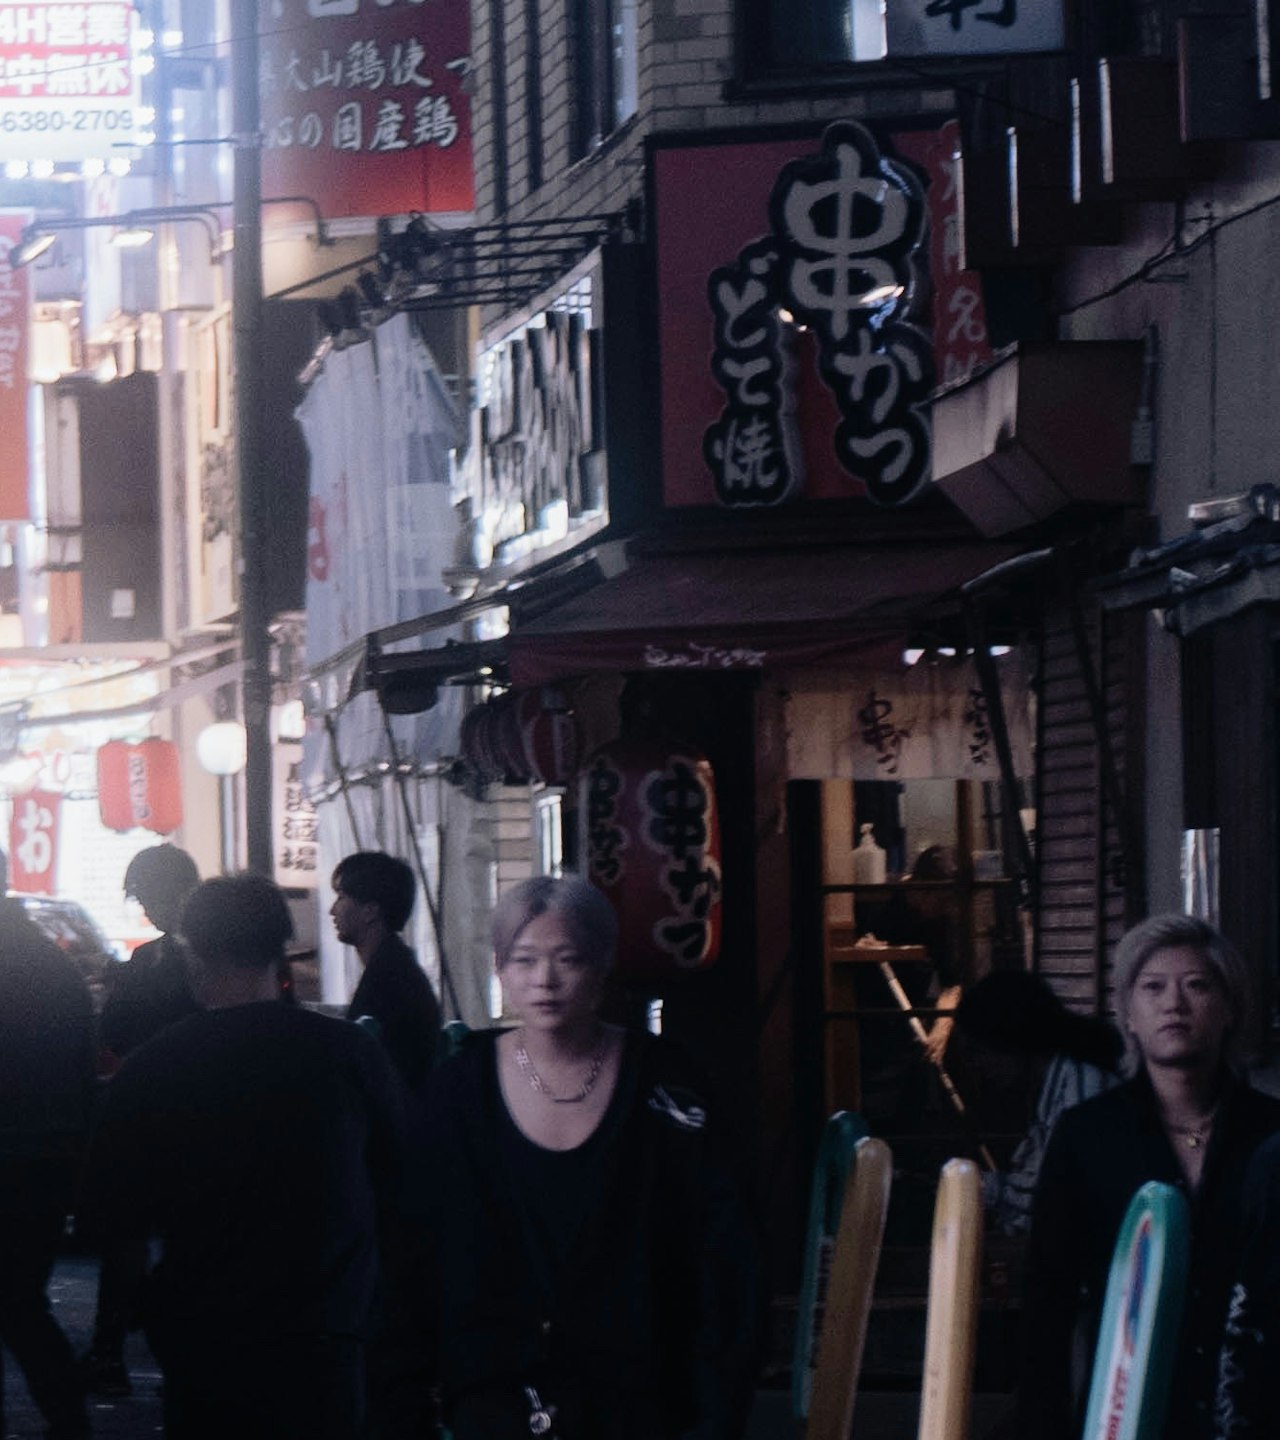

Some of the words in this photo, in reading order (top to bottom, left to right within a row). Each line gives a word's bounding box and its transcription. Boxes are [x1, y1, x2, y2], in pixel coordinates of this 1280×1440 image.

[713, 257, 783, 489] どて焼
[786, 144, 923, 489] 串かつ
[646, 761, 719, 963] 串かつ
